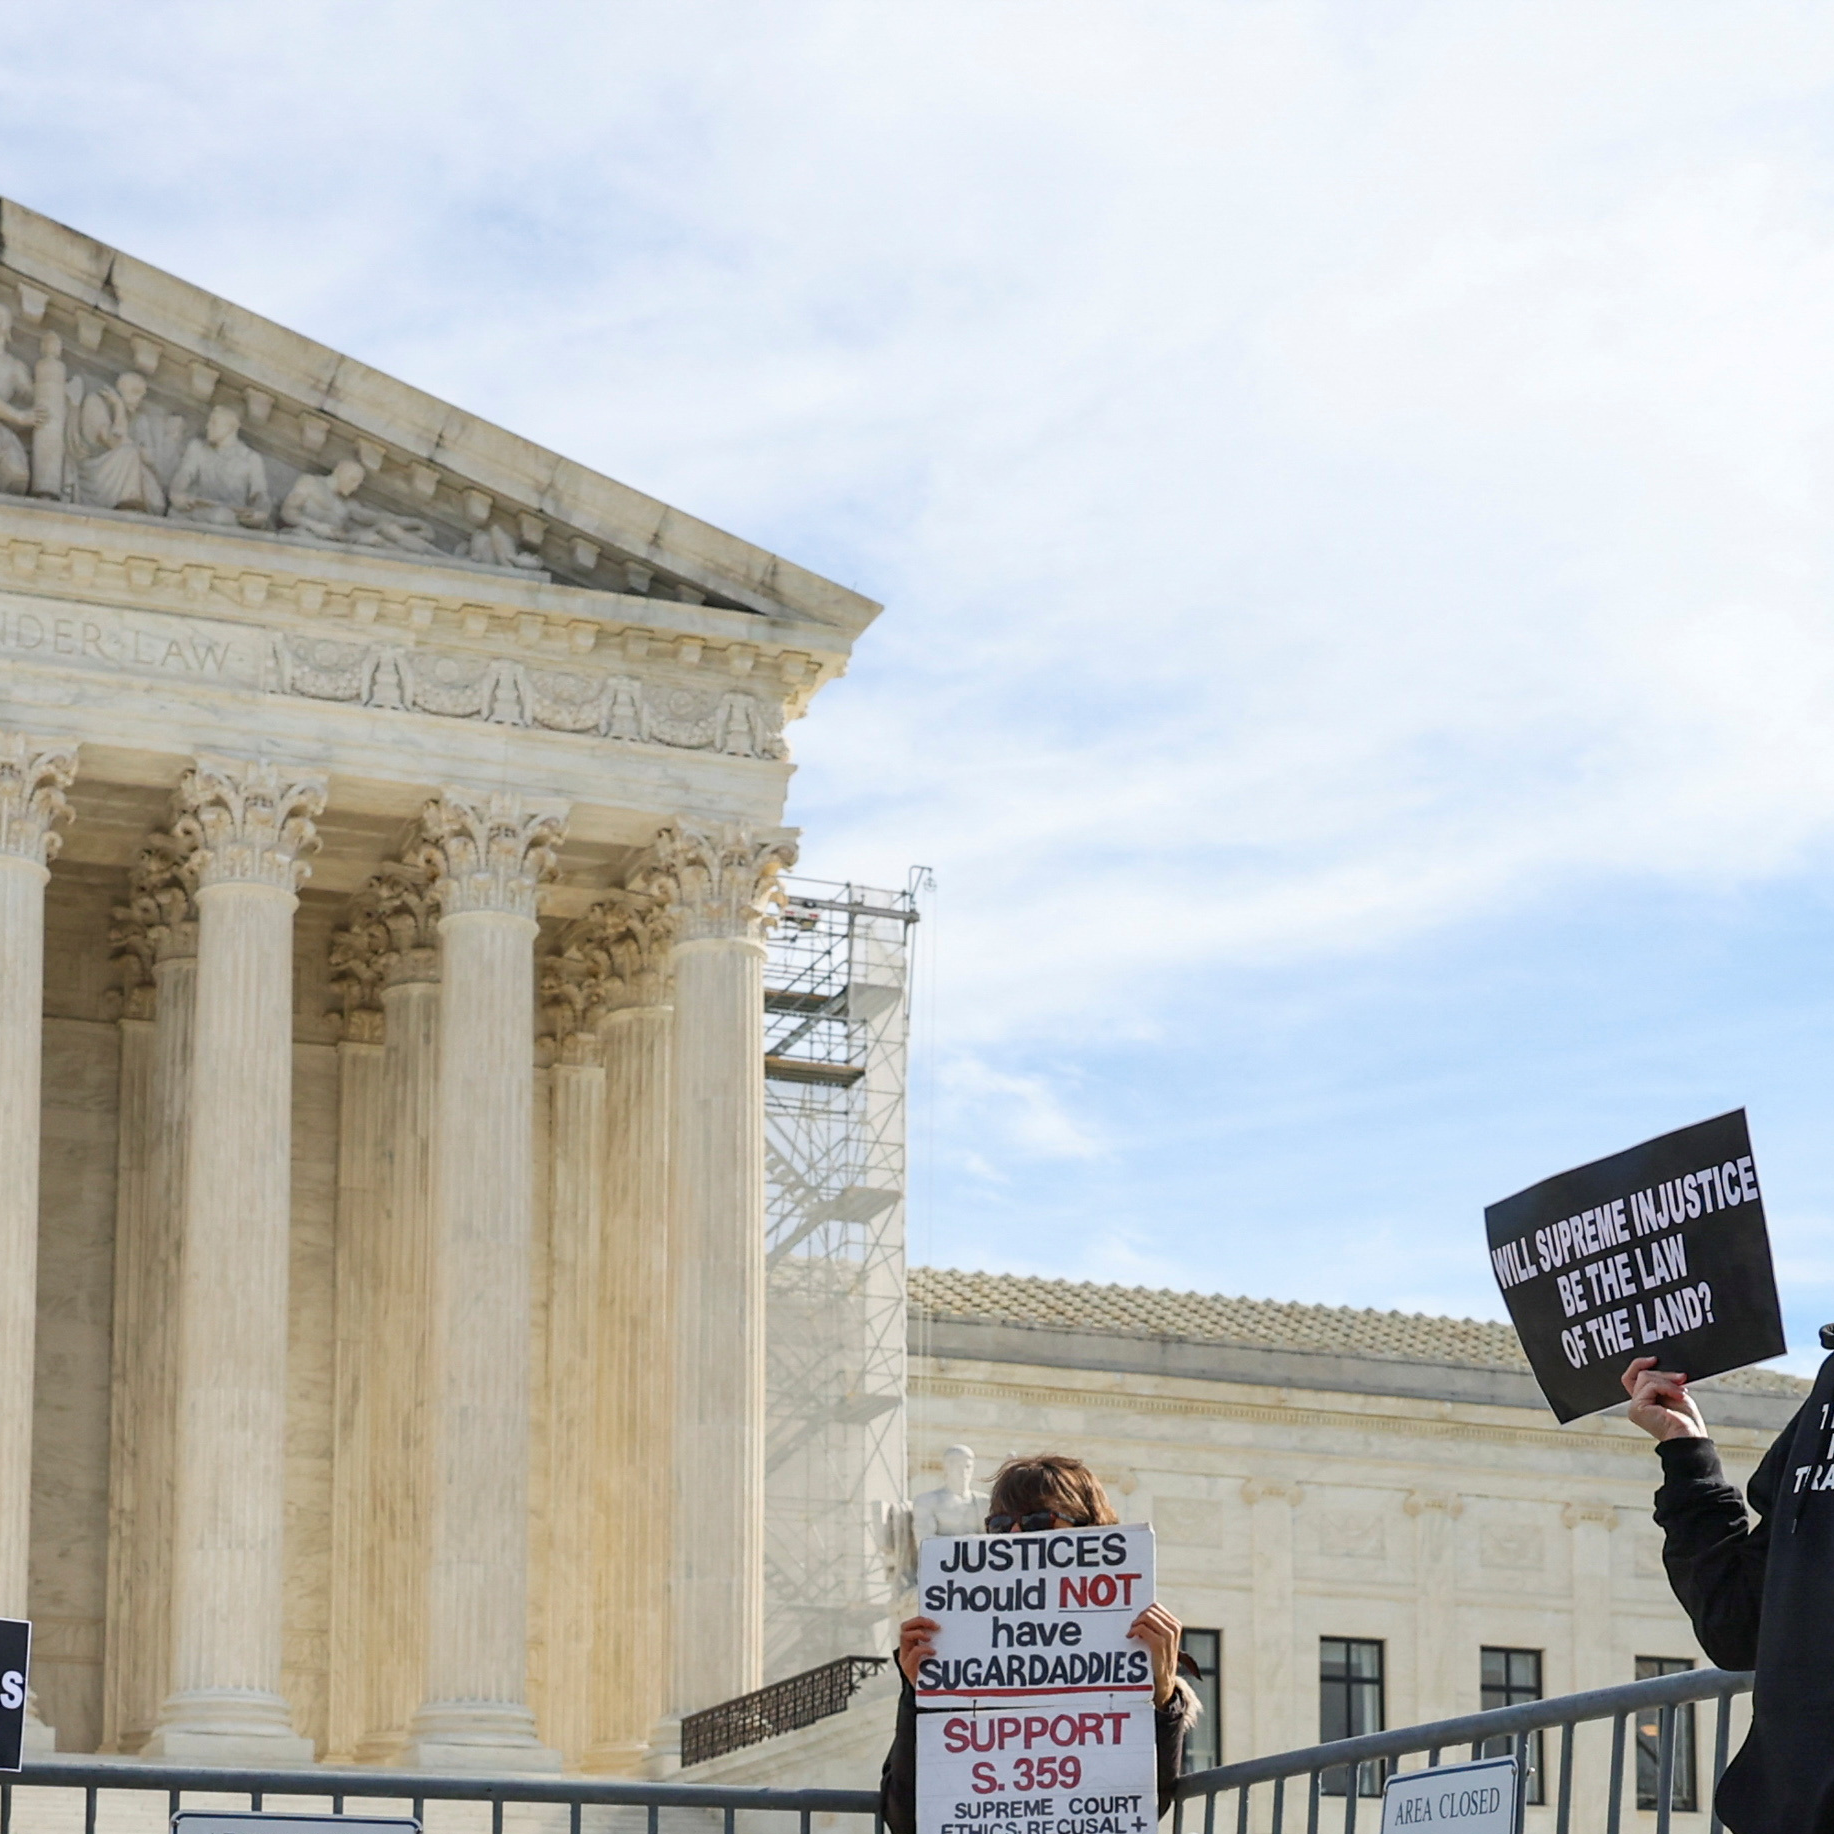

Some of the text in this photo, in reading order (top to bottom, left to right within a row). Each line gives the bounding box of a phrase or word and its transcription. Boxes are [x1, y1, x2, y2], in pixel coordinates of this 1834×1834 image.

[133, 629, 234, 673] LAW
[1491, 1155, 1759, 1290] WILL SUPREME INJUSTICE
[1557, 1233, 1687, 1318] BE THE LAW
[1561, 1281, 1715, 1369] OF THE LAND?
[940, 1533, 1126, 1573] JUSTICES
[925, 1573, 1142, 1612] should NOT
[991, 1616, 1082, 1648] have
[918, 1650, 1148, 1690] SUGARDADDIES
[943, 1712, 1131, 1753] SUPPORT
[971, 1755, 1082, 1794] S. 359
[954, 1795, 1142, 1819] SUPREME COURT
[1395, 1788, 1500, 1826] AREA CLOSED
